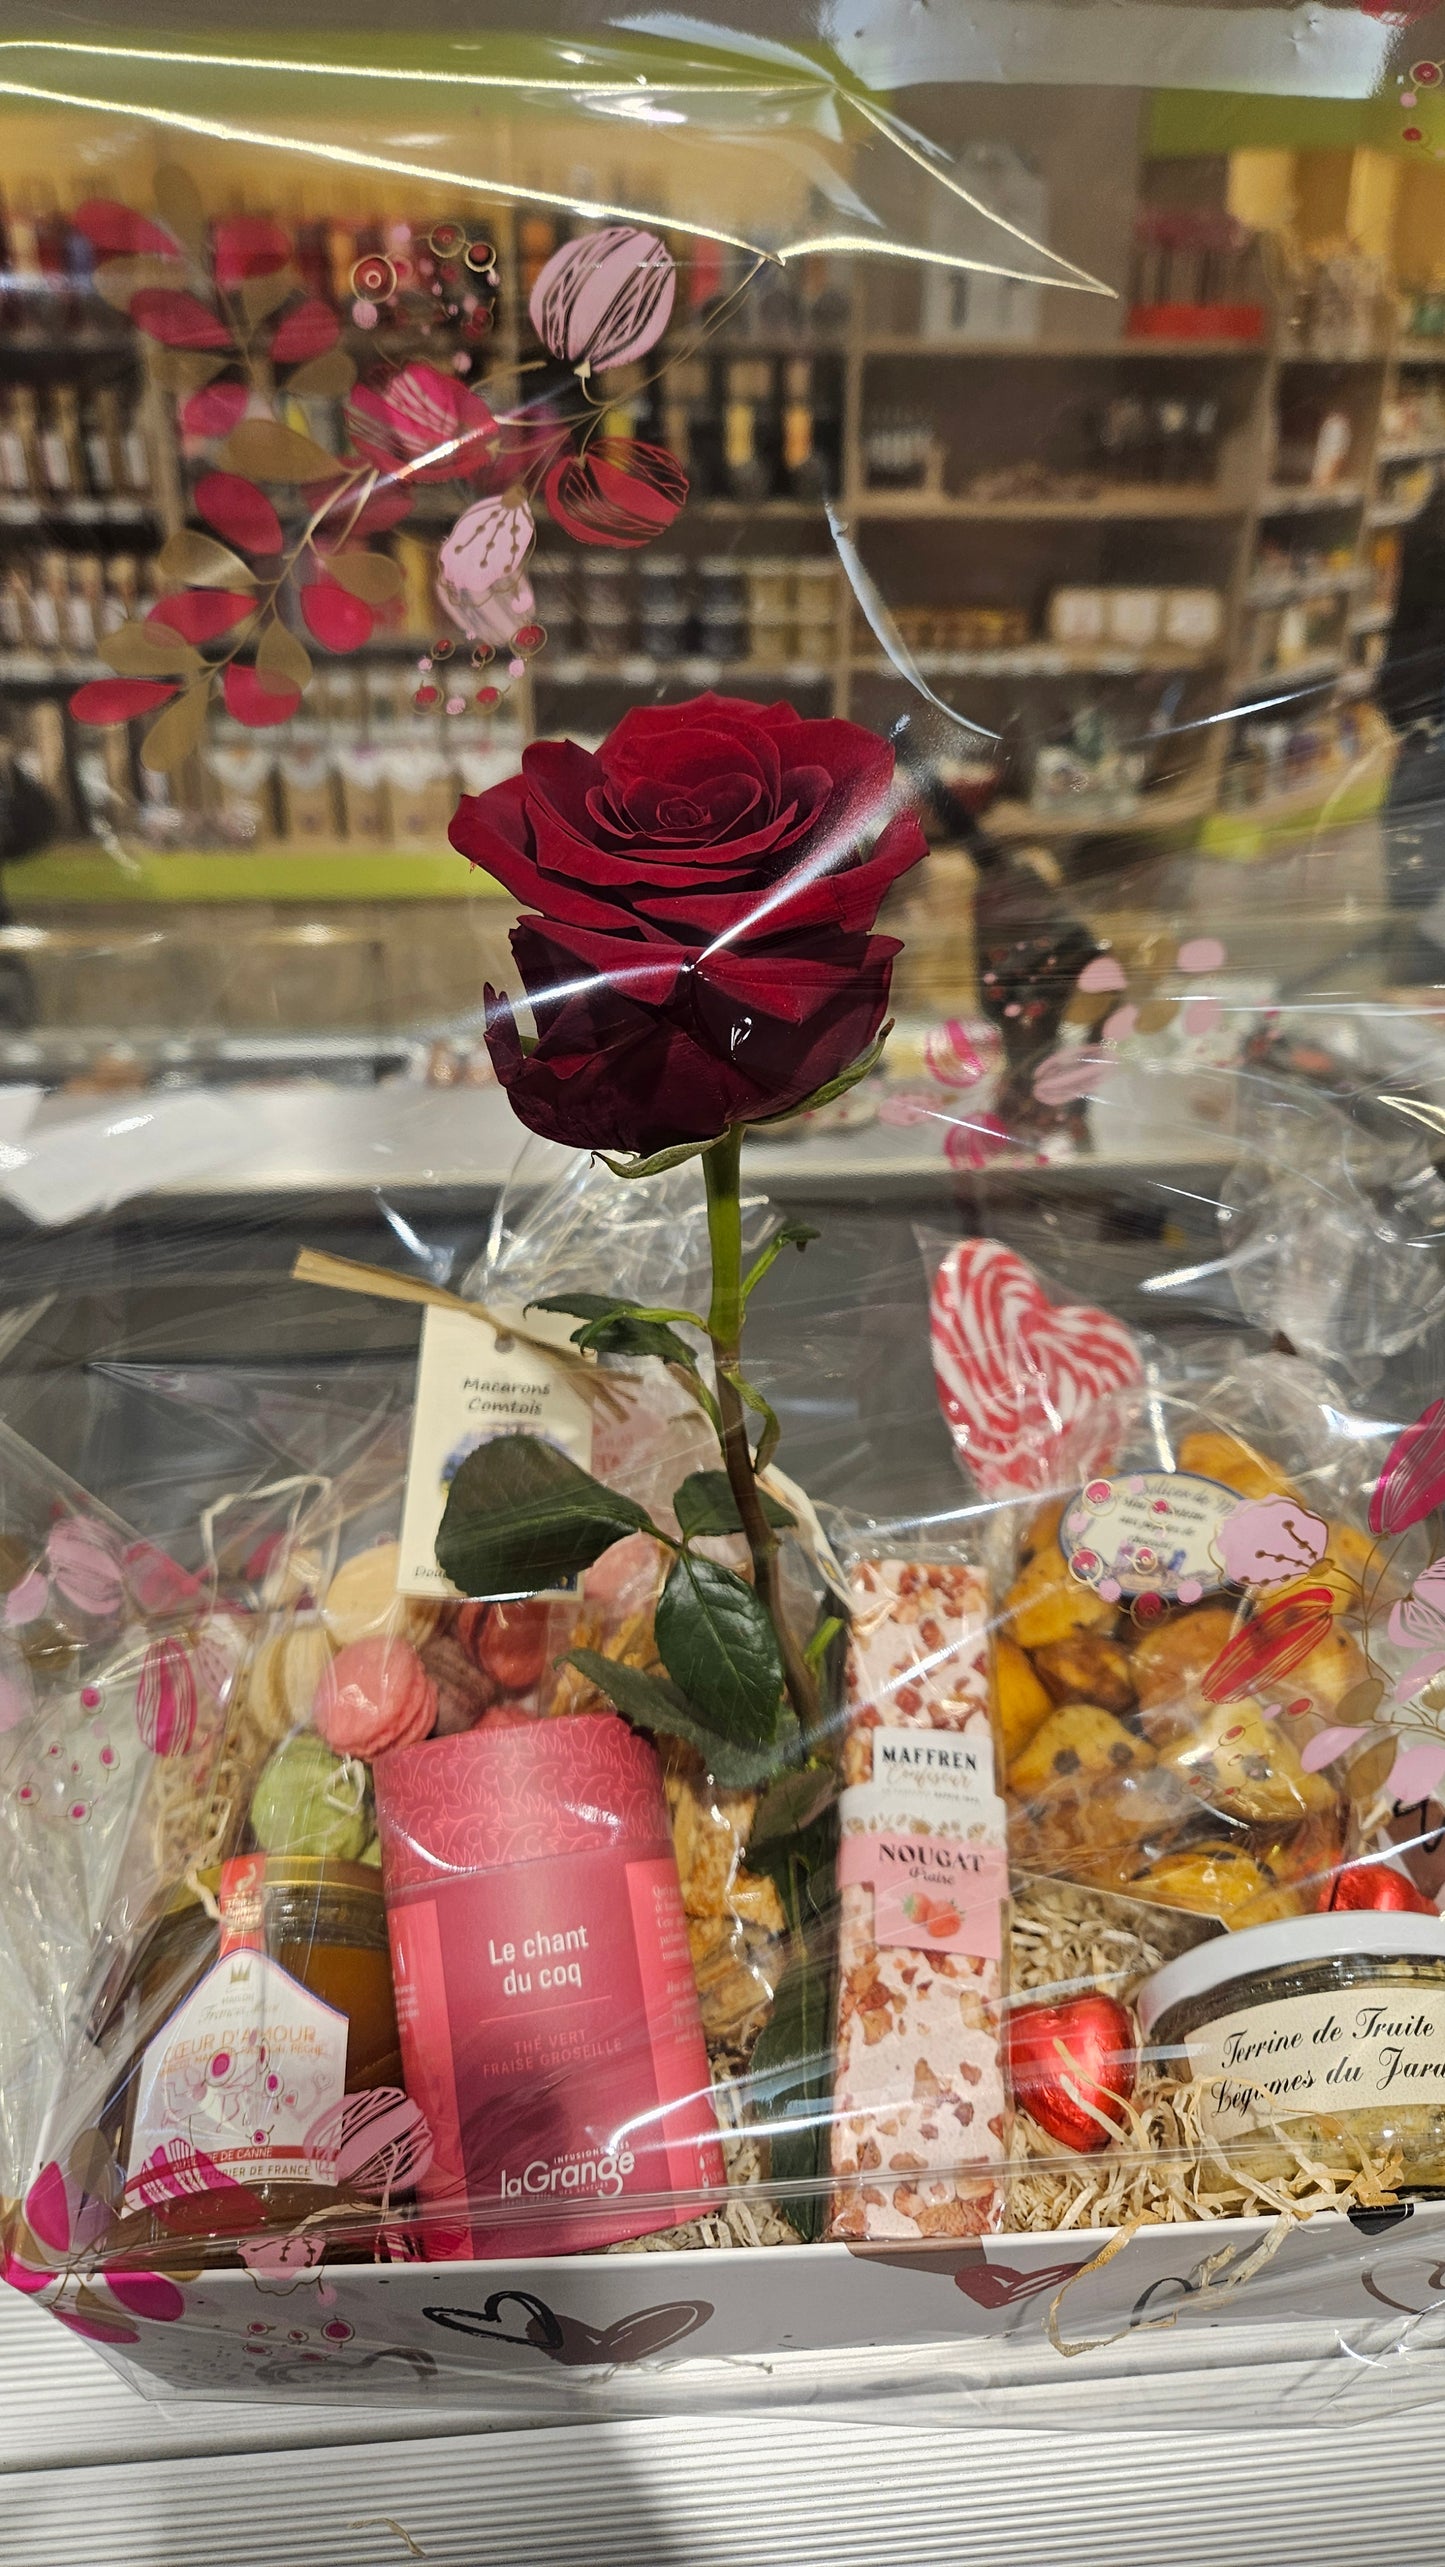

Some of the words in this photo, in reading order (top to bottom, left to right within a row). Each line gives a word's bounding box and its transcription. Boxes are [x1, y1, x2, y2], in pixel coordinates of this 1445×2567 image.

[463, 1378, 550, 1395] Macarons
[468, 1397, 543, 1416] Comtois
[882, 1746, 977, 1772] MAFFREN
[879, 1843, 985, 1873] NOUGAT
[488, 1939, 516, 1965] Le
[523, 1925, 589, 1959] chant
[503, 1968, 532, 1997] du
[538, 1962, 582, 1990] coq
[548, 2029, 586, 2048] VERT
[1221, 2029, 1304, 2069] Terrine
[1312, 2015, 1344, 2045] de
[1352, 2006, 1435, 2040] Truite
[483, 2056, 533, 2078] FRAISE
[540, 2037, 623, 2066] GROSEILLE
[1326, 2056, 1365, 2085] du
[220, 2149, 234, 2161] DE
[237, 2145, 273, 2159] CANNE
[249, 2167, 263, 2176] DE
[268, 2164, 312, 2176] FRANCE
[500, 2151, 635, 2199] laGrange
